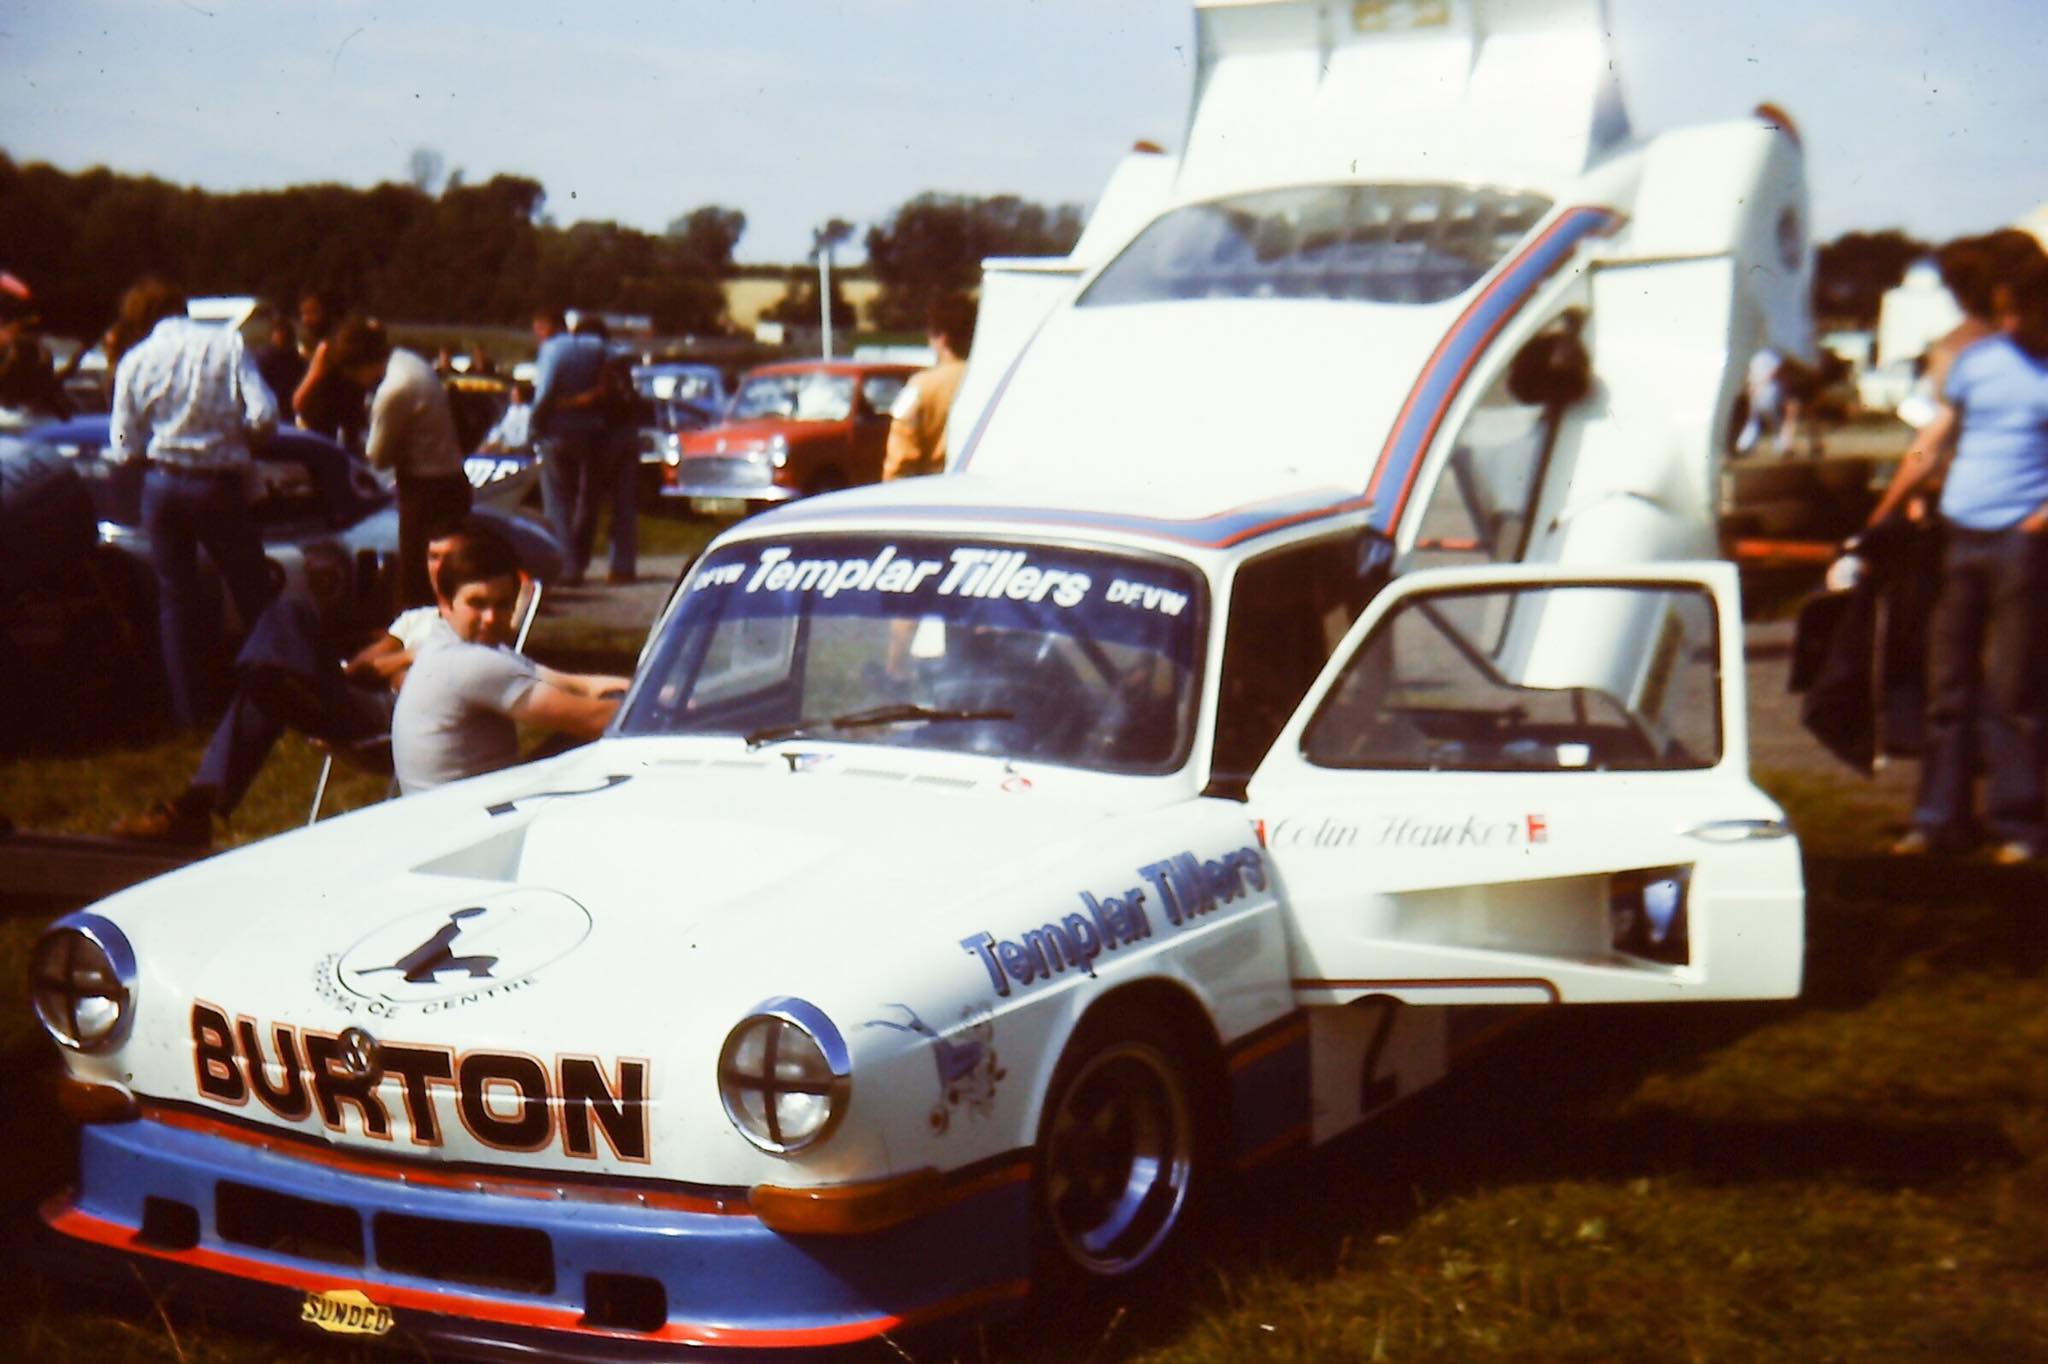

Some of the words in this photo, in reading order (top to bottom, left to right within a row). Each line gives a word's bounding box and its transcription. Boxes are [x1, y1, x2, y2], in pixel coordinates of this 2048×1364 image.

[746, 545, 942, 598] Templar
[937, 547, 1091, 607] Tillers
[1105, 579, 1188, 616] DFVW
[1270, 817, 1358, 847] Colin
[1379, 814, 1519, 847] Hawker
[959, 890, 1152, 998] Templar
[1136, 846, 1267, 927] Tillers
[421, 974, 538, 1015] CENTRE
[188, 998, 652, 1165] BURTON
[302, 1291, 394, 1333] SUNOCO
